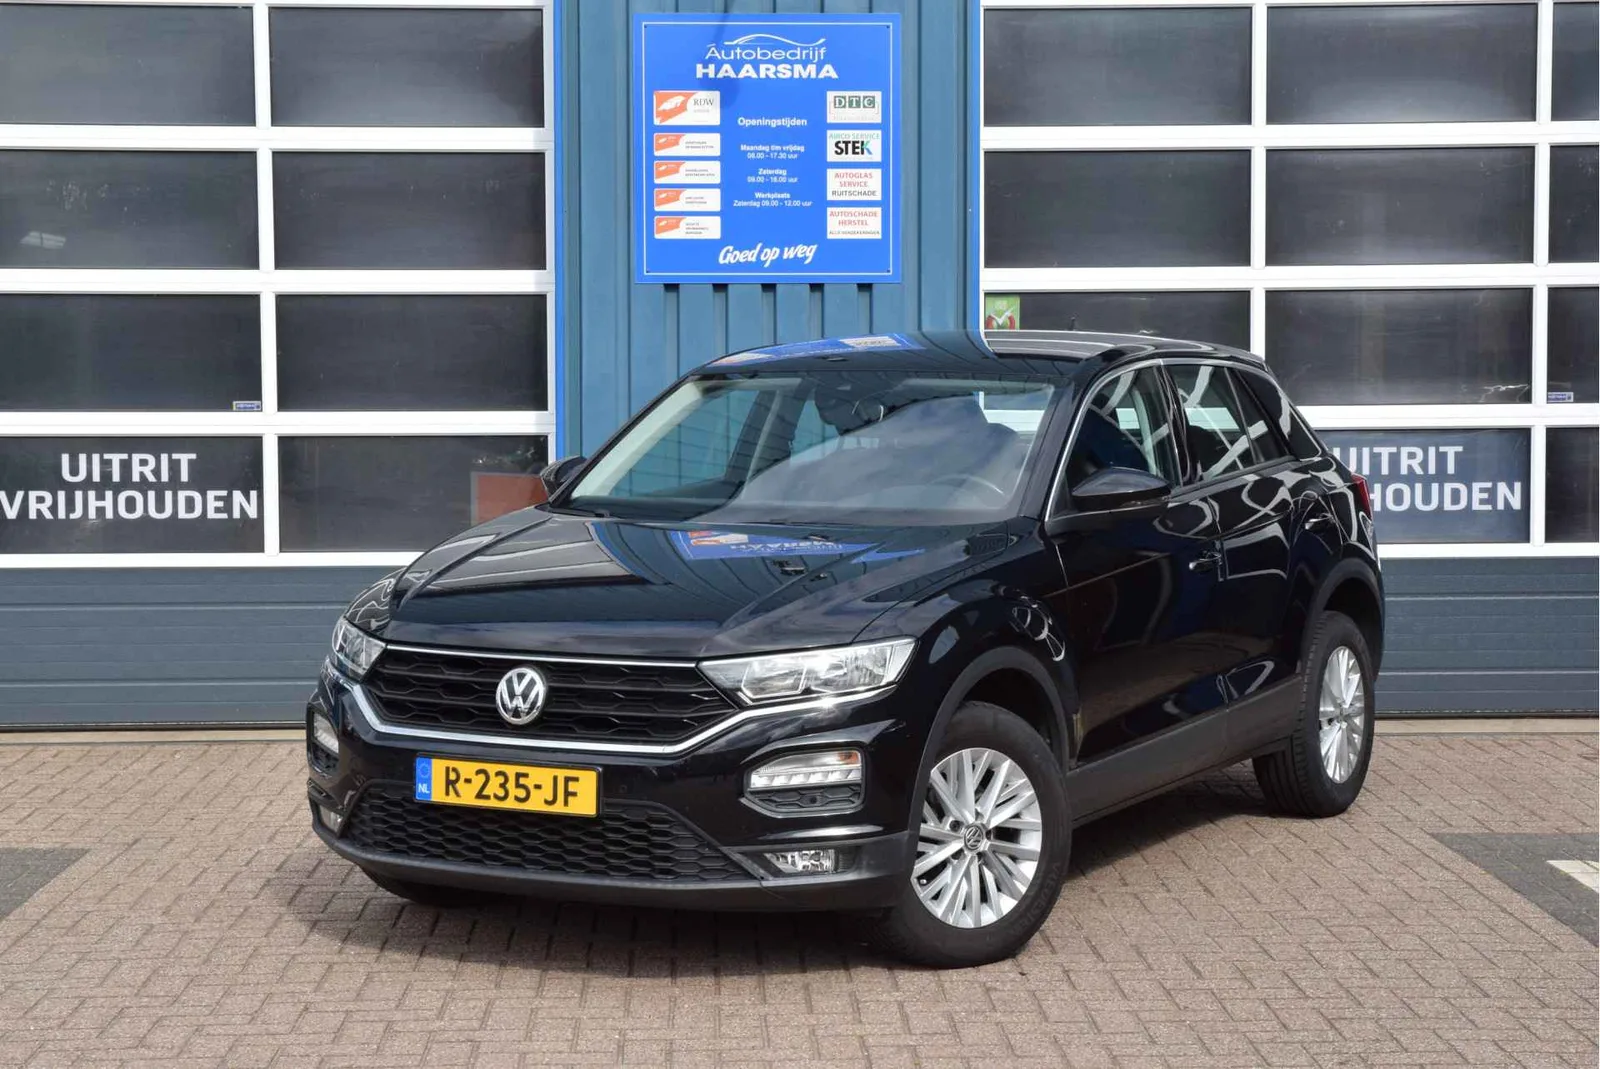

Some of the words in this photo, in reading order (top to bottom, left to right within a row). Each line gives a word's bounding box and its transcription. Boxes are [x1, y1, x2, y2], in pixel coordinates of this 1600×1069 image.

[696, 63, 839, 79] HAARSMA
[693, 98, 715, 106] RDW
[834, 96, 875, 108] DTC
[737, 116, 807, 128] Openingstijden
[829, 132, 850, 140] AIRCO
[852, 132, 880, 140] SERVICE
[740, 144, 770, 152] Maandag
[782, 144, 805, 153] vrijdag
[834, 140, 873, 156] STEK
[758, 167, 788, 176] Zaterdag
[754, 191, 791, 200] Werkplaats
[733, 199, 761, 208] Zaterdag
[718, 243, 763, 265] Goed
[760, 246, 780, 268] op
[782, 243, 818, 265] weg
[1332, 446, 1464, 476] UITRIT
[61, 453, 197, 483] UITRIT
[1370, 481, 1522, 512] HOUDEN
[0, 490, 258, 520] VRIJHOUDEN
[417, 782, 431, 794] NL
[445, 766, 580, 808] R-235-JF
